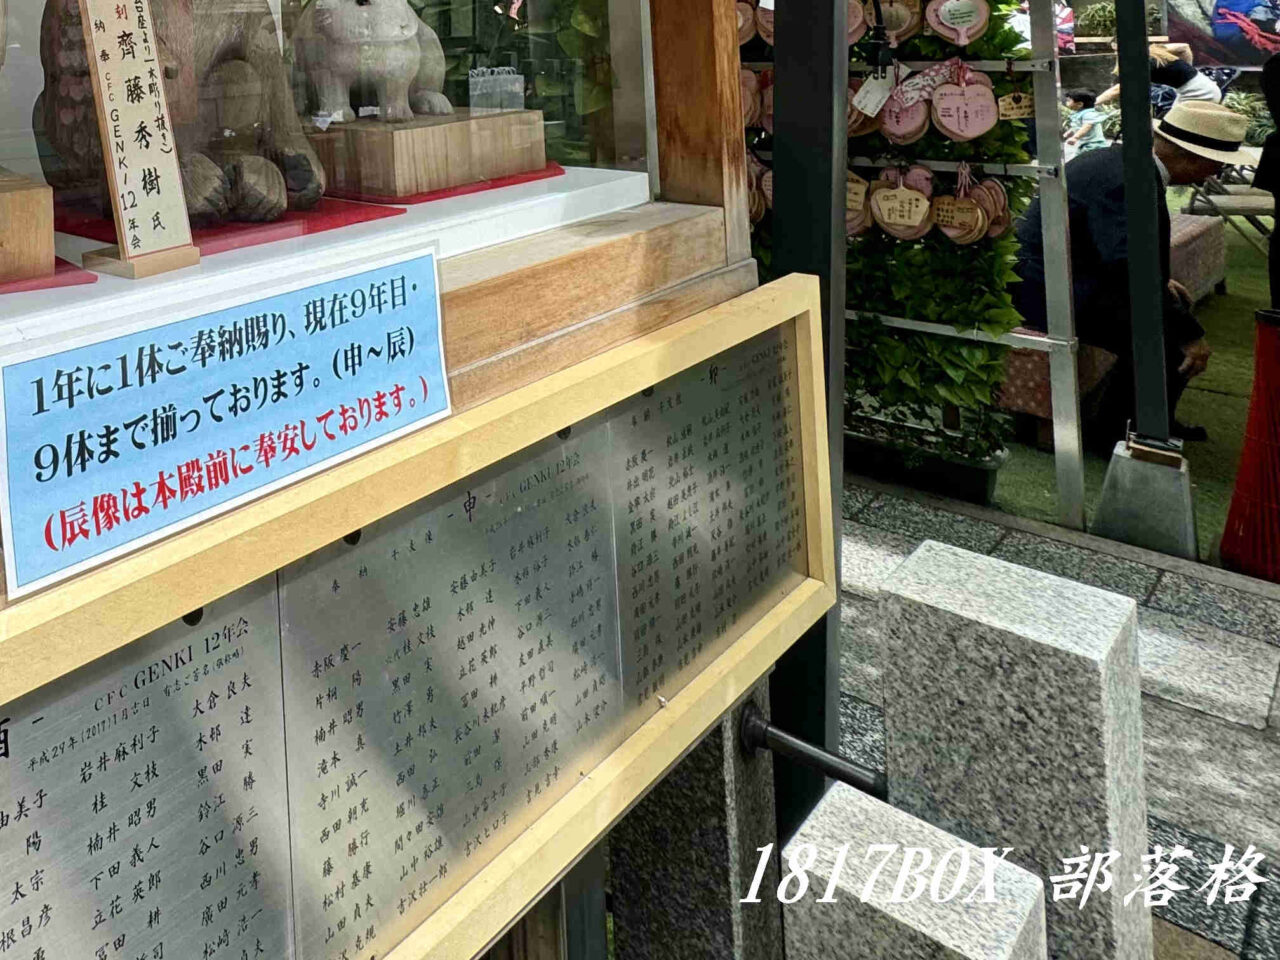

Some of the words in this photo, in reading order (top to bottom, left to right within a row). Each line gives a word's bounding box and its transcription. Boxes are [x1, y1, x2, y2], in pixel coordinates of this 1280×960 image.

[463, 491, 476, 522] 申
[94, 683, 128, 712] CFC
[134, 644, 193, 690] GENKI
[204, 616, 249, 654] 12年会
[192, 690, 219, 719] 大倉
[226, 671, 253, 700] 良夫
[239, 705, 253, 725] 達
[80, 725, 160, 784] 岩井麻利子
[197, 759, 223, 788] 黒田
[242, 738, 253, 759] 実
[91, 791, 108, 814] 桂
[130, 760, 160, 792] 文枝
[26, 830, 42, 856] 陽
[87, 821, 120, 856] 楠井
[127, 797, 156, 827] 昭男
[199, 830, 224, 856] 谷口
[89, 861, 120, 890] 下田
[129, 836, 160, 867] 義人
[200, 861, 226, 890] 西川
[10, 869, 45, 905] 太宗
[91, 894, 123, 930] 立花
